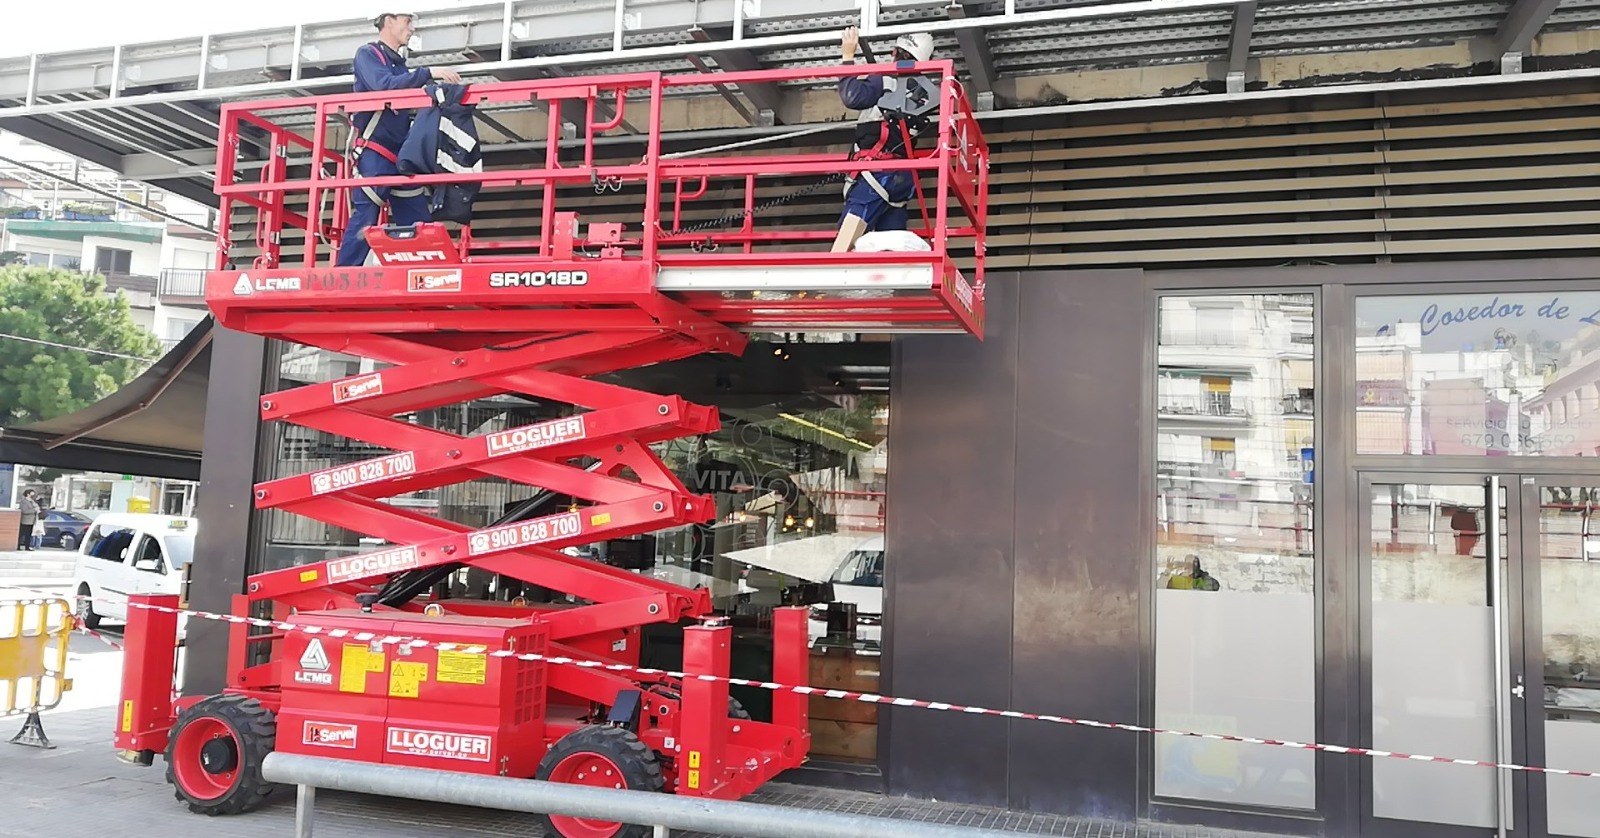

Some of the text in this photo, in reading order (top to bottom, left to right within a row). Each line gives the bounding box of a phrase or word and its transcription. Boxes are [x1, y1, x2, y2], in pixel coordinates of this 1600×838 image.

[382, 250, 446, 262] HILTI
[489, 270, 588, 288] SR1018D
[1420, 297, 1526, 335] Cosedor
[1537, 297, 1570, 320] de
[490, 419, 581, 451] LLOGUER
[1461, 433, 1495, 449] 679
[332, 455, 411, 487] 900 828 700
[692, 470, 746, 490] VITA
[491, 528, 518, 548] 900
[521, 522, 548, 542] 828
[550, 516, 577, 536] 700
[331, 548, 414, 577] LLOGUER
[391, 730, 487, 755] LLOGUER
